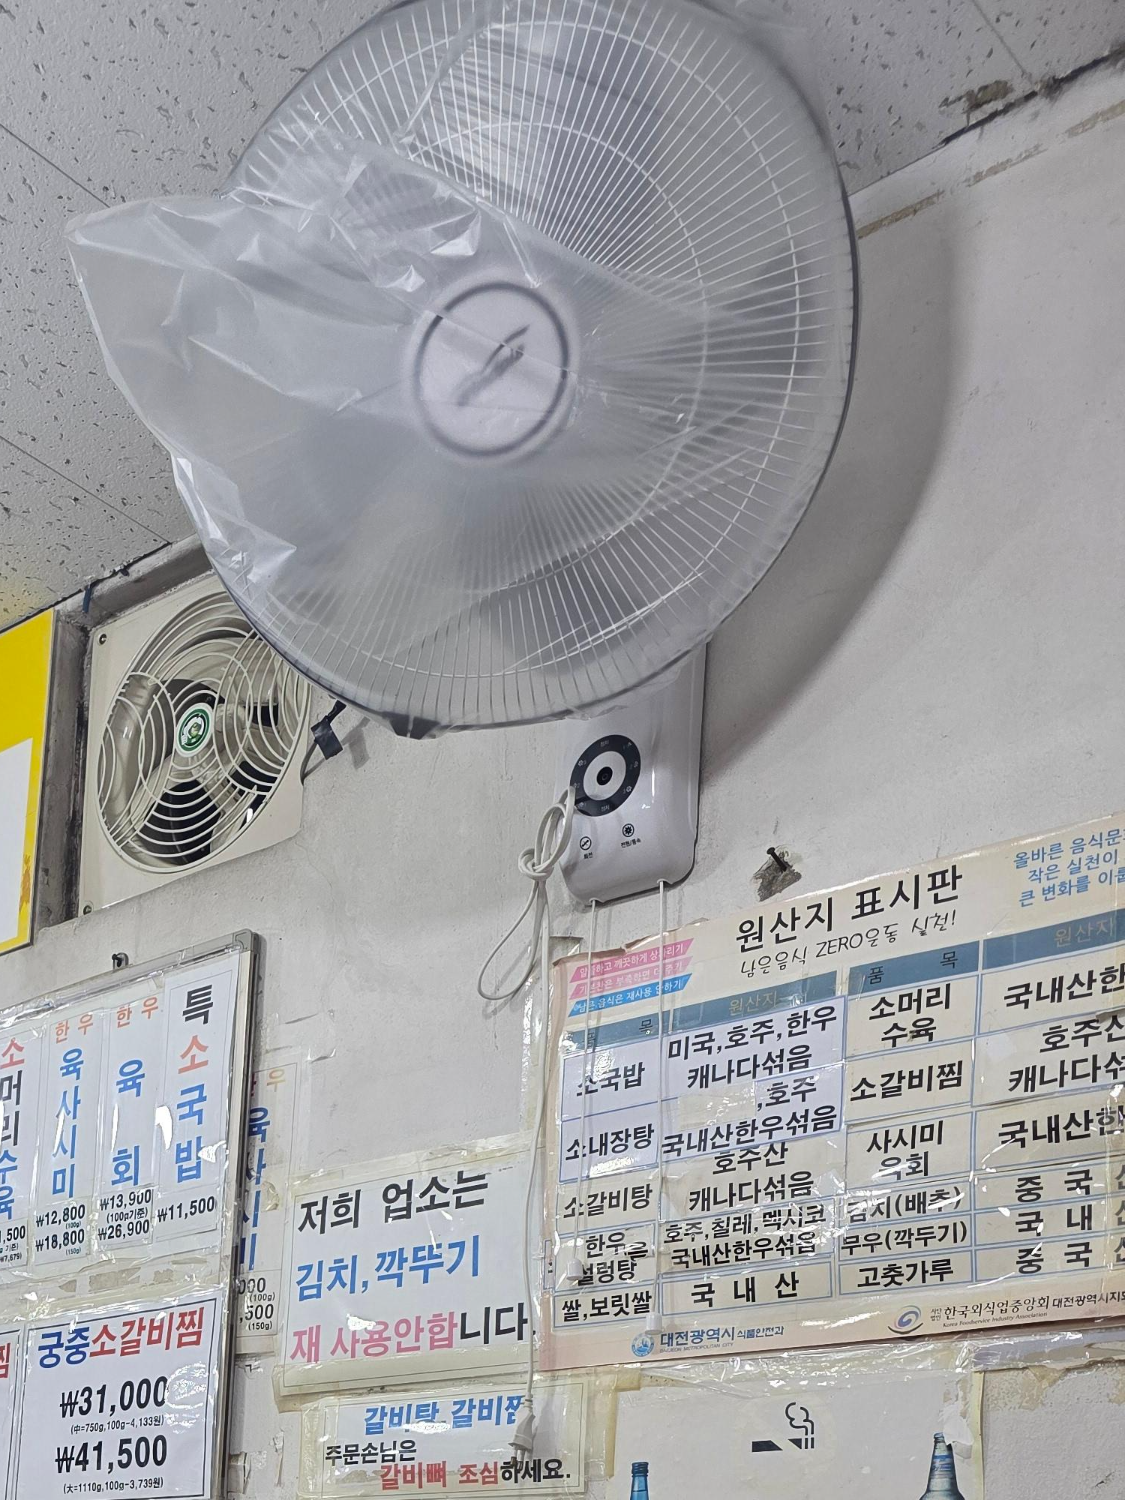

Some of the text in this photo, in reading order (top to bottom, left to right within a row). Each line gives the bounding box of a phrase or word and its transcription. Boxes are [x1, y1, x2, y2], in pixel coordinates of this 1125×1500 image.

[1013, 828, 1125, 869] 올바른 음식문
[1028, 848, 1118, 883] 작은 실천이
[735, 864, 963, 953] 원산지 표시판
[1019, 890, 1035, 907] 큰
[1042, 875, 1091, 901] 변화를
[117, 996, 159, 1028] 한우
[869, 983, 951, 1021] 소머리
[55, 1013, 94, 1044] 한우
[881, 1017, 937, 1048] 수육
[175, 984, 214, 1183] 특소국밥
[687, 1044, 813, 1089] 캐나다섞음
[850, 1060, 963, 1101] 소갈비찜
[52, 1047, 85, 1198] 육사시미
[662, 1104, 838, 1157] 국내산한우섞음
[866, 1120, 943, 1154] 사시미
[565, 1123, 655, 1161] 소내장탕
[712, 1141, 789, 1175] 호주산
[298, 1170, 488, 1234] 저희 업소는
[564, 1183, 653, 1218] 소갈비탕
[689, 1171, 814, 1212] 캐나다섞음
[36, 1204, 86, 1228] ₩12,800
[157, 1196, 216, 1223] ₩11,500
[35, 1229, 85, 1252] ₩18,800
[97, 1219, 150, 1241] ₩26,900
[671, 1232, 817, 1269] 국내산한우섞음
[857, 1258, 954, 1288] 고춧가루
[562, 1290, 653, 1322] 쌀,보릿쌀
[944, 1296, 1050, 1321] 한국외식업중앙회
[38, 1307, 204, 1369] 궁중소갈비찜
[290, 1324, 321, 1363] 재
[660, 1326, 735, 1347] 대전광역시
[60, 1376, 168, 1418] ₩31,000
[55, 1434, 168, 1474] ₩41,500
[325, 1439, 417, 1466] 주문손님은
[380, 1458, 571, 1491] 갈비뼈 조심하세요.
